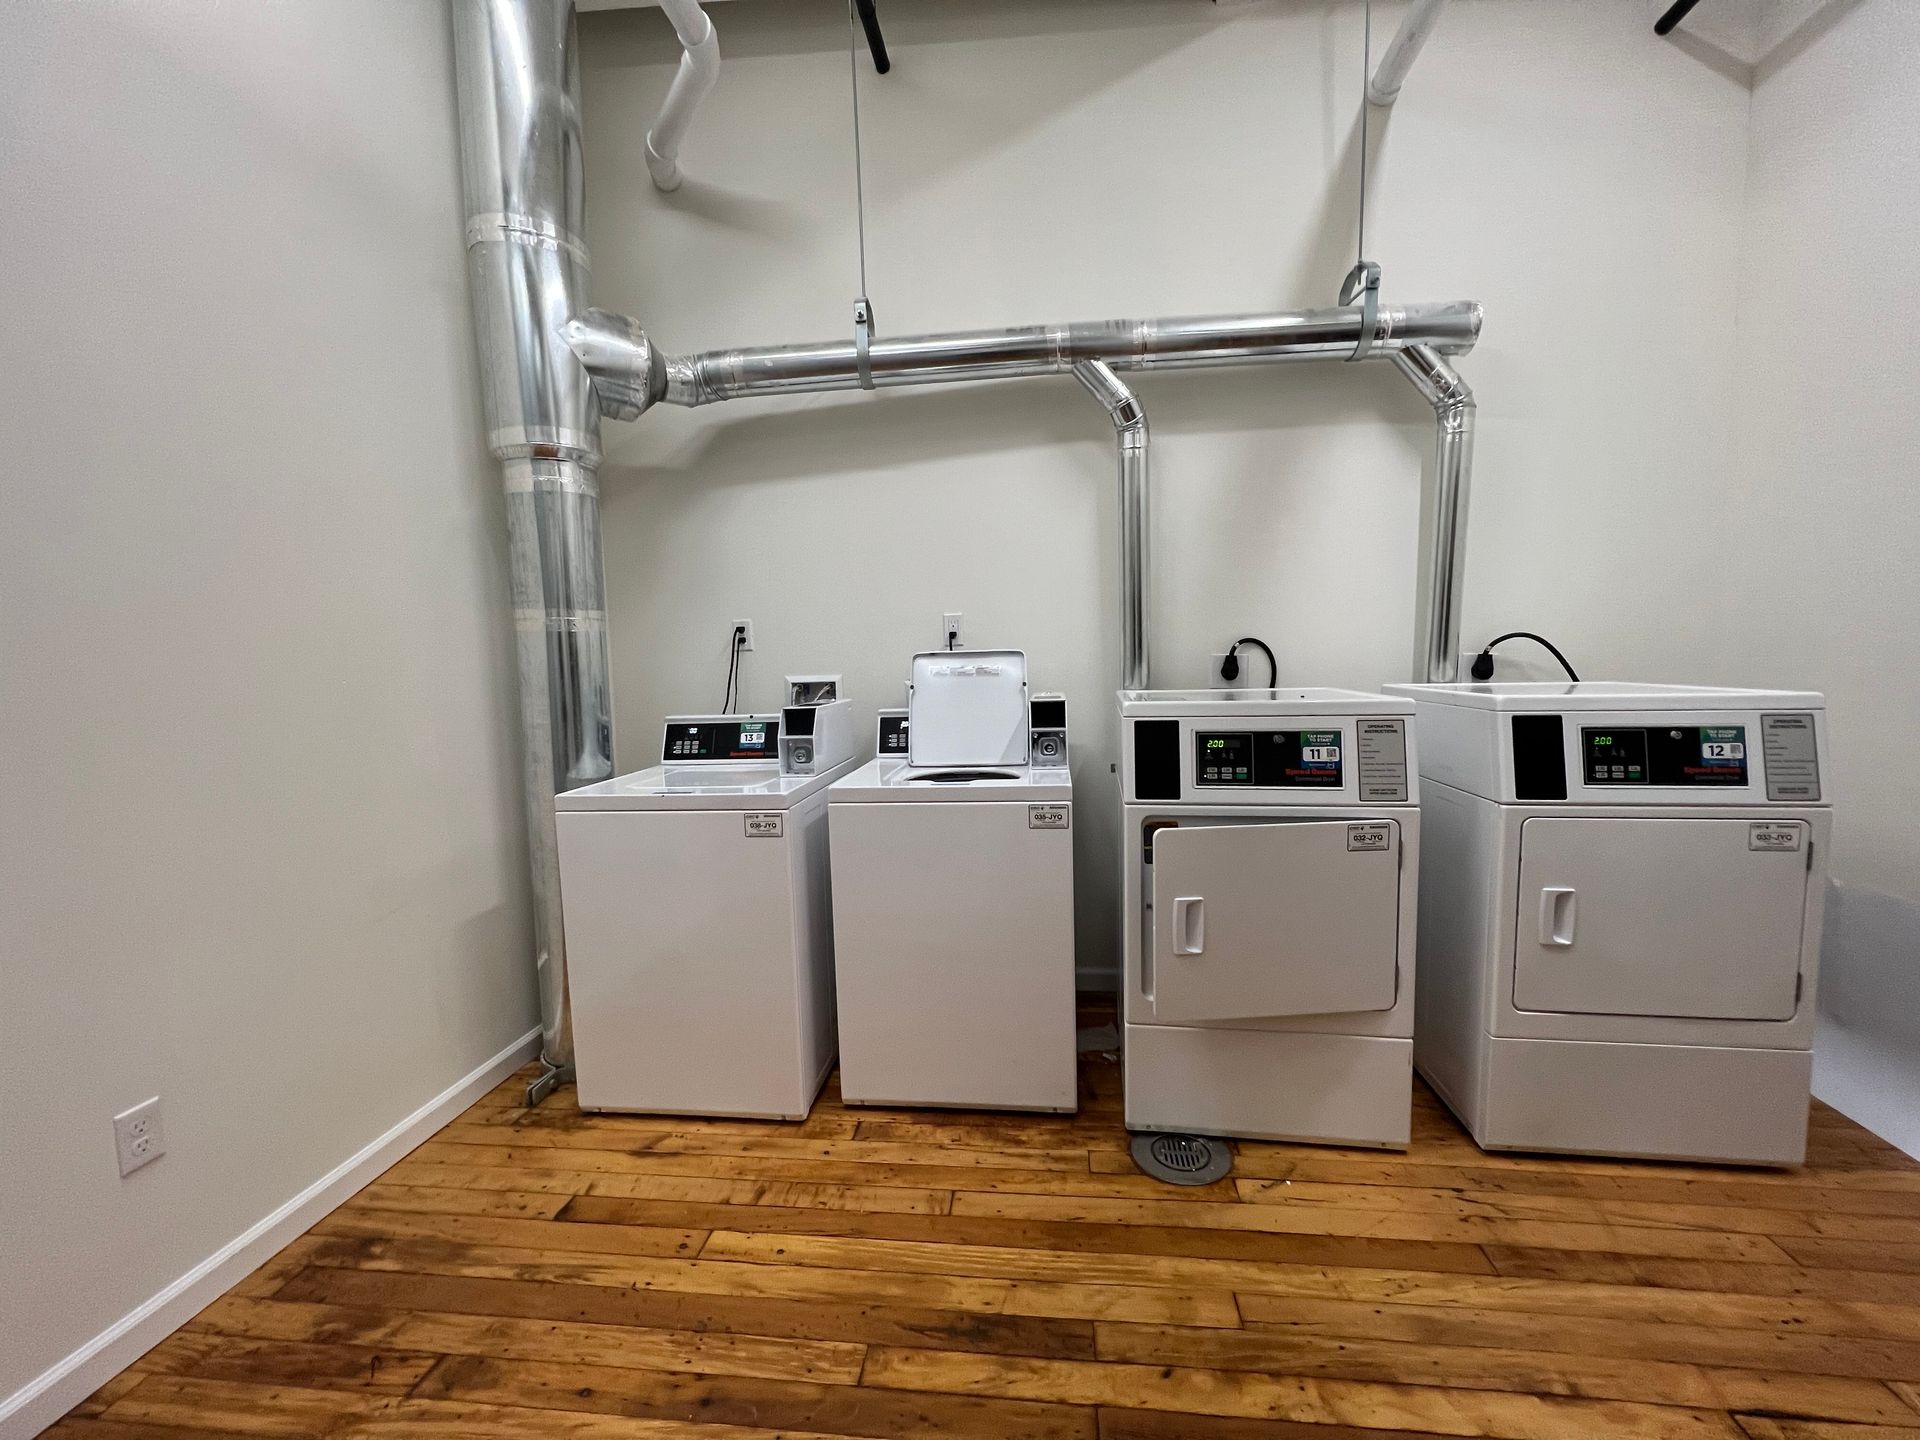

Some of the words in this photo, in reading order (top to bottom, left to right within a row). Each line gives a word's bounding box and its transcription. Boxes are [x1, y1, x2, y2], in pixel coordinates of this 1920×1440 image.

[744, 734, 754, 742] 13
[1309, 748, 1320, 760] 11
[1708, 745, 1724, 757] 12
